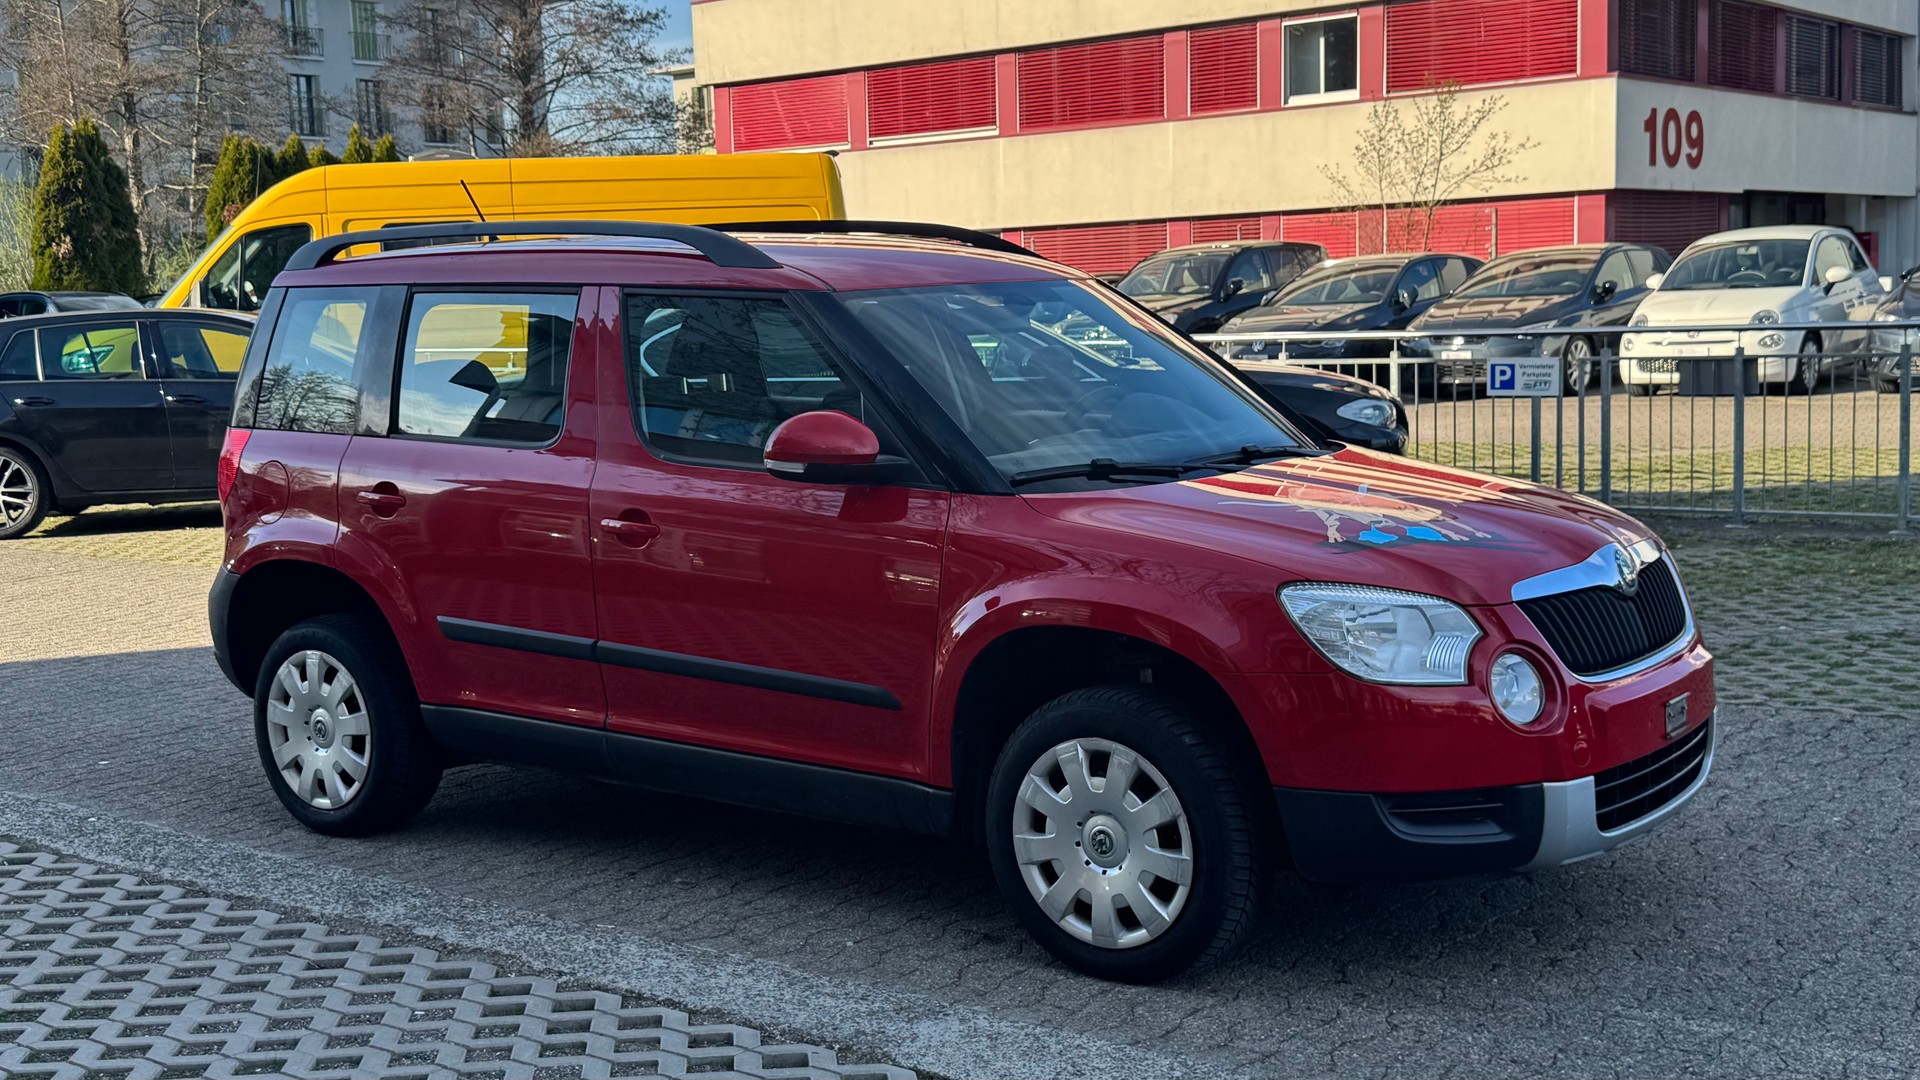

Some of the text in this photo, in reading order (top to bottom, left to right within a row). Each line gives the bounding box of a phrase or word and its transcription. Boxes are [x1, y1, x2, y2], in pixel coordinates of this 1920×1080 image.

[1643, 107, 1704, 170] 109
[1494, 365, 1512, 389] P
[1522, 371, 1552, 379] Parkplatz
[1313, 628, 1340, 640] Yeti
